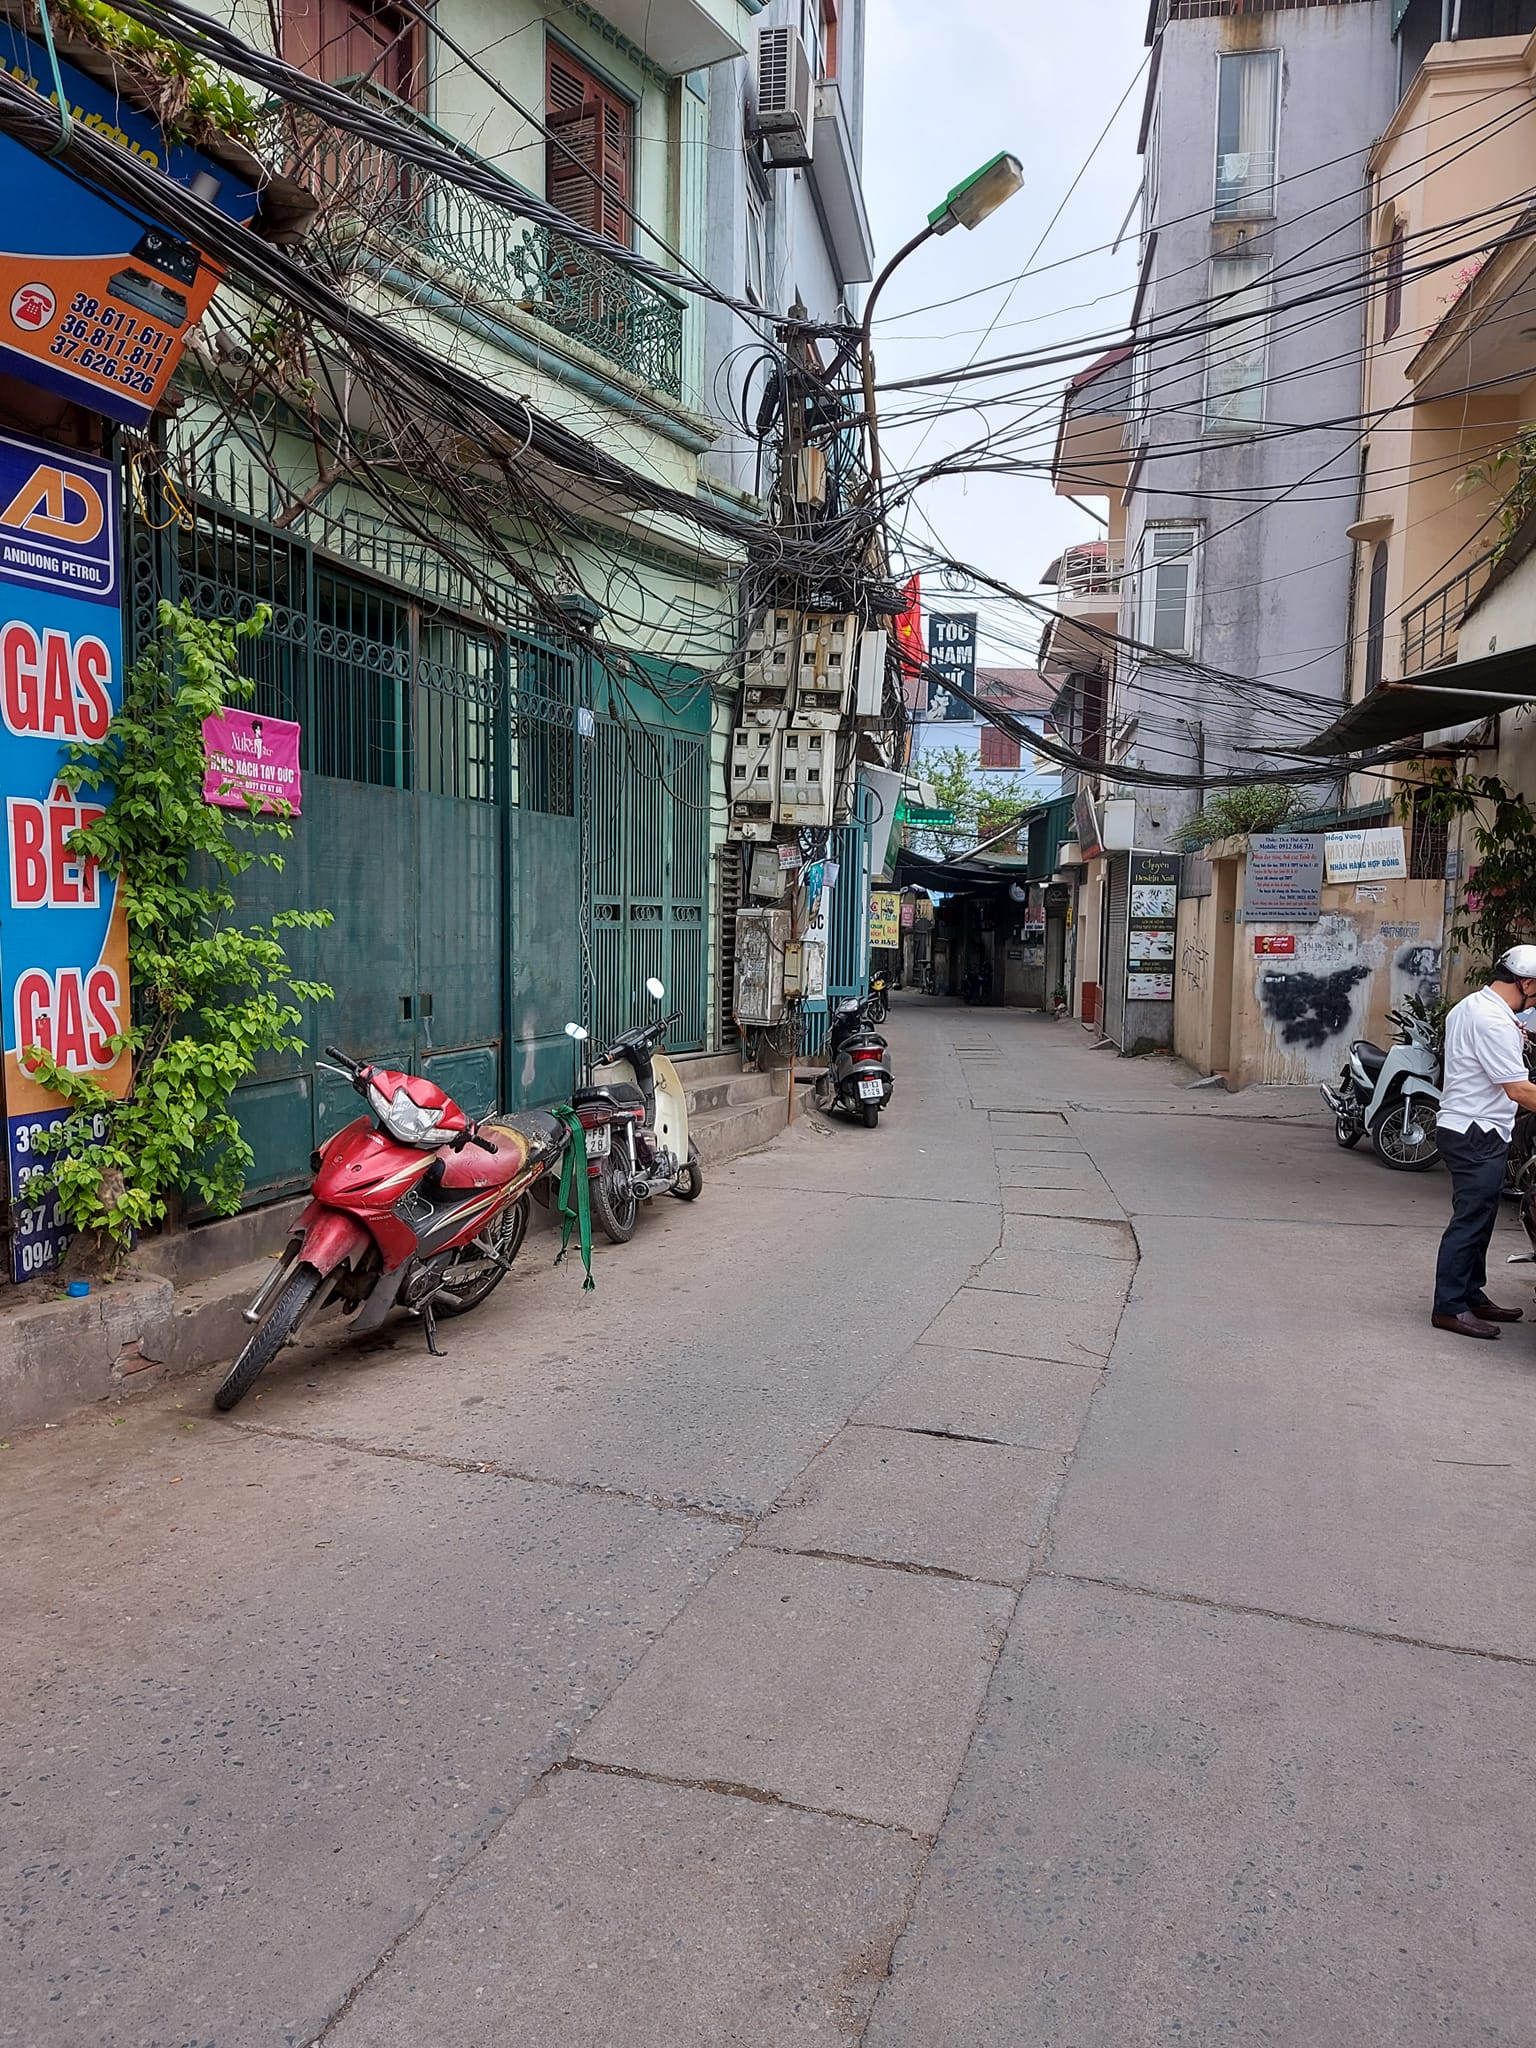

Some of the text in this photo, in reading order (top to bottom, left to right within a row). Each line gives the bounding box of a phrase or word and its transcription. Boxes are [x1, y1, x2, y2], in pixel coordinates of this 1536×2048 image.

[60, 313, 164, 376] 36.811.811
[70, 292, 175, 356] 38.611.611
[49, 335, 156, 395] 37.626.326
[0, 464, 104, 544] AD
[3, 545, 102, 583] ANDUONG PETROL
[931, 646, 973, 665] NAM
[936, 621, 969, 641] TÓC
[2, 621, 112, 743] GAS
[236, 759, 259, 778] XÁCH
[260, 764, 276, 780] TAY
[277, 766, 294, 783] ĐỨC
[1330, 862, 1347, 872] NHẬN
[1349, 861, 1367, 869] HÀNG
[1368, 860, 1380, 869] HỢP
[15, 966, 120, 1078] GAS
